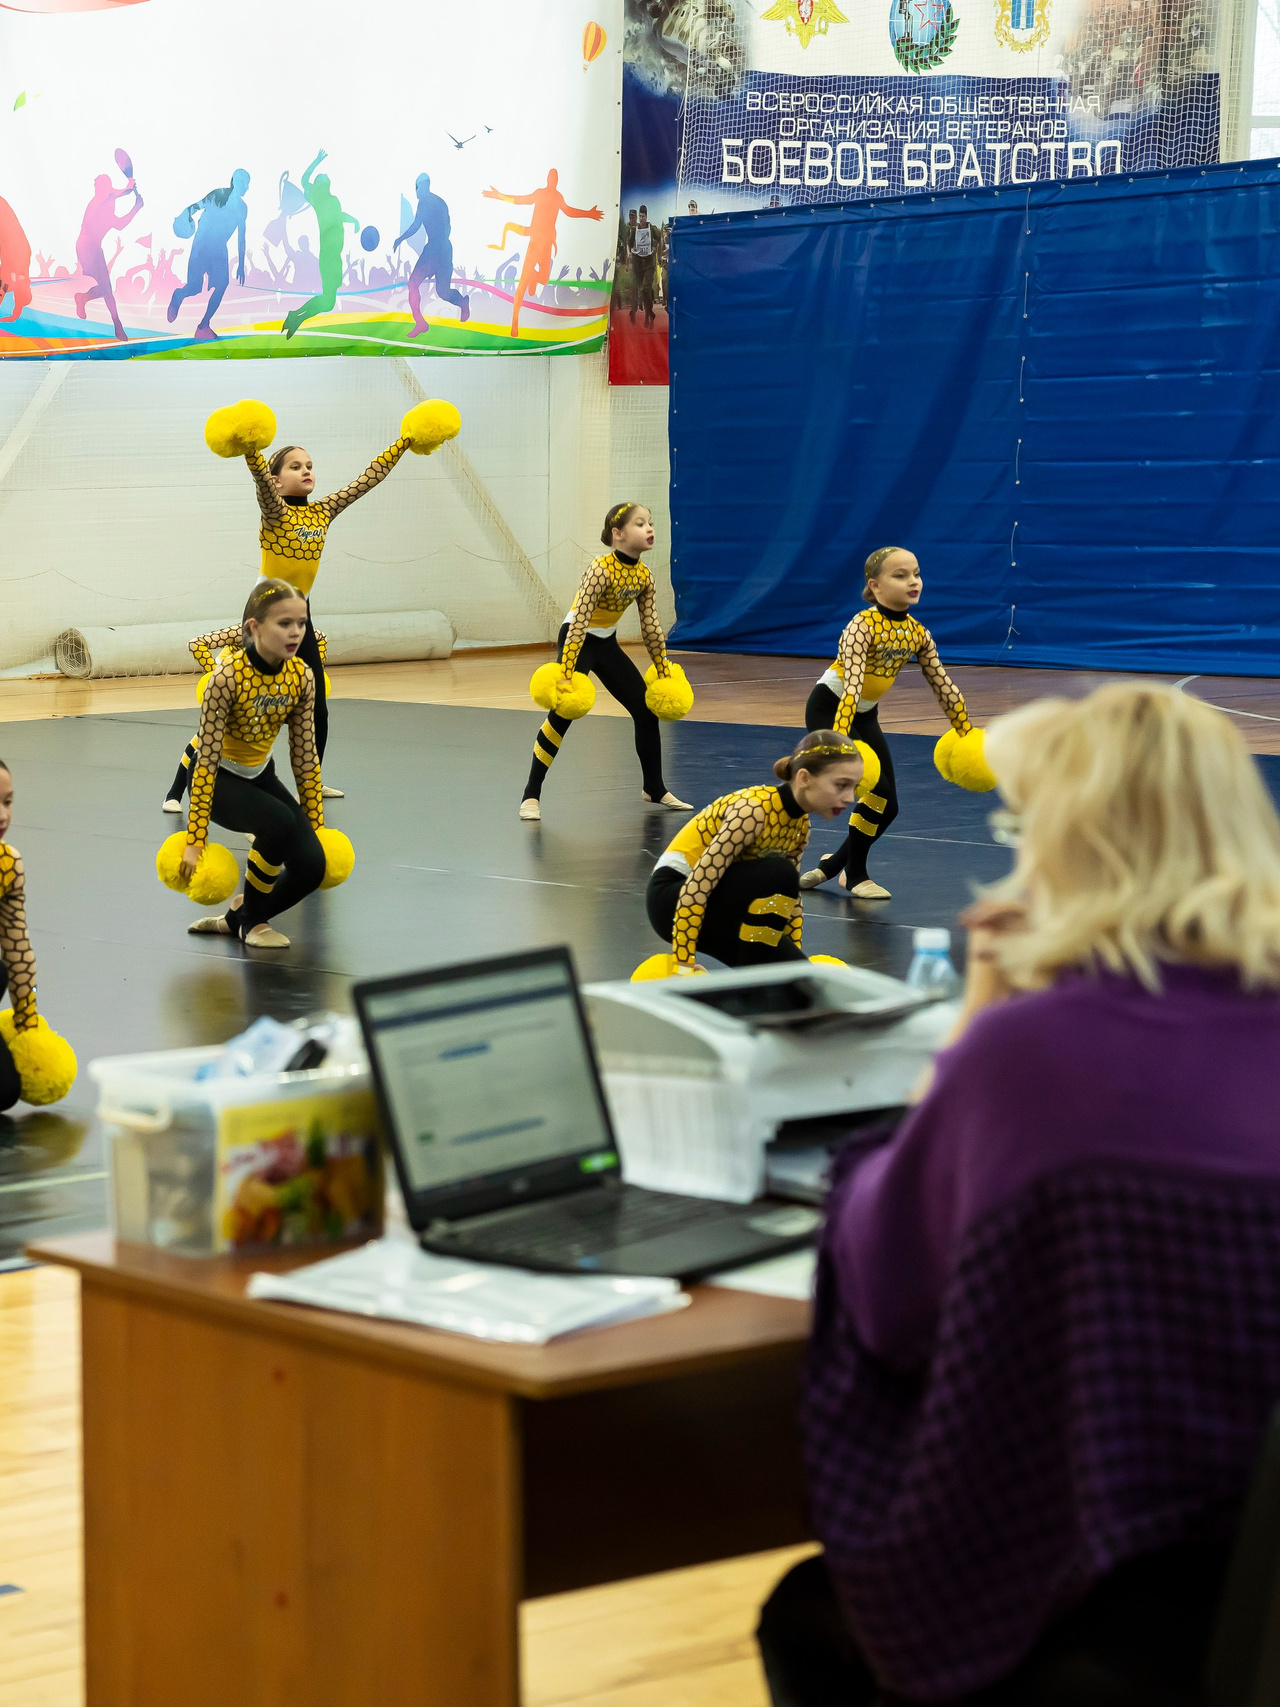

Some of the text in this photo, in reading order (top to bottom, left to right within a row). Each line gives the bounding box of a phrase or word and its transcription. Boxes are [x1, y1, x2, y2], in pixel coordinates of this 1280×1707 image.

[746, 91, 1101, 118] ВСЕРОССИЙКАЯ ОБЩЕСТВЕННАЯ
[779, 117, 1068, 140] ОРГАНИЗАЦИЯ ВЕТЕРАНОВ
[721, 138, 889, 187] БОЕВОЕ
